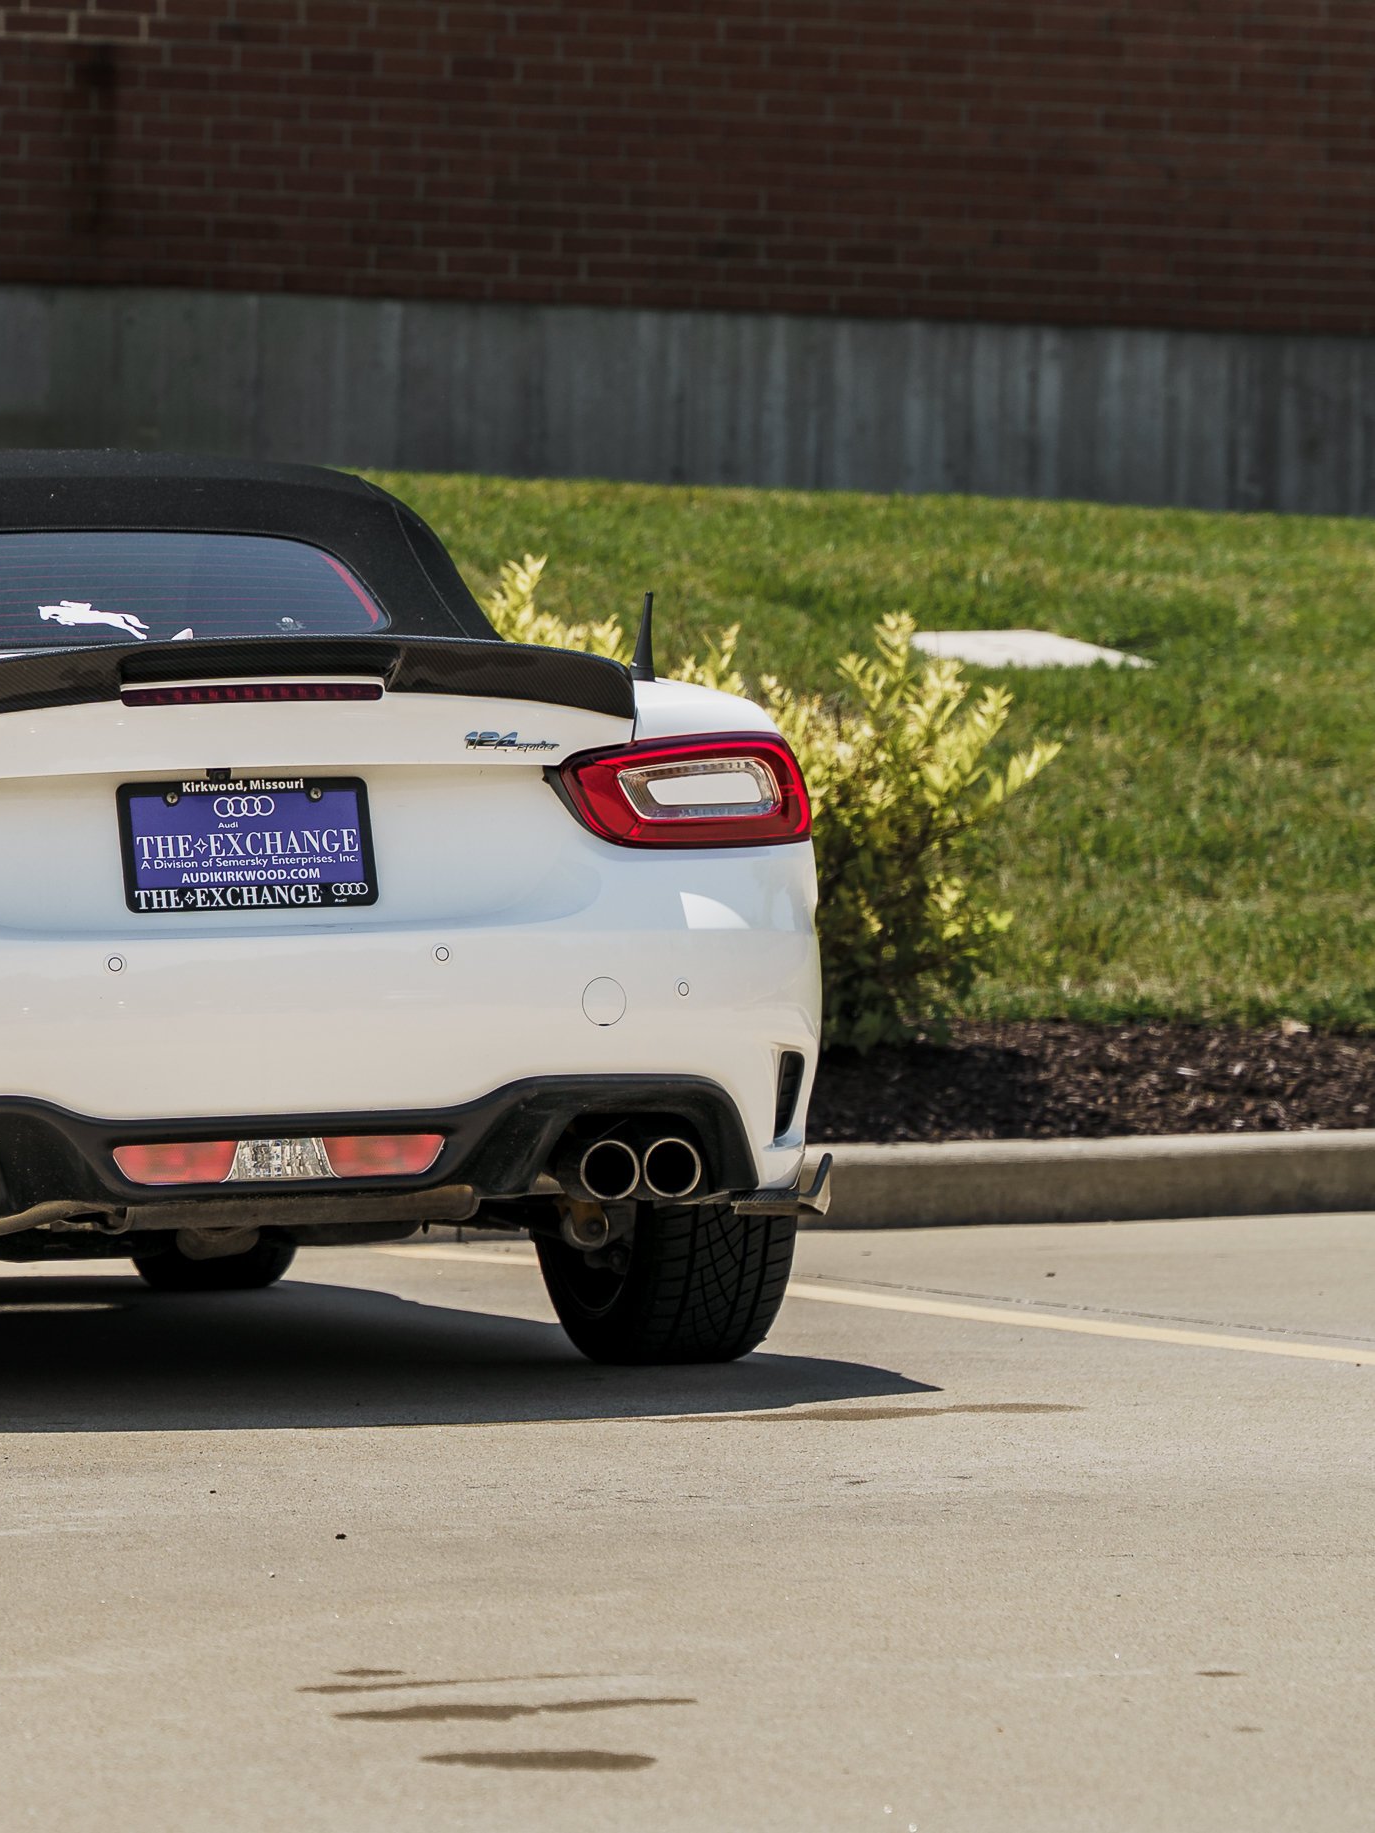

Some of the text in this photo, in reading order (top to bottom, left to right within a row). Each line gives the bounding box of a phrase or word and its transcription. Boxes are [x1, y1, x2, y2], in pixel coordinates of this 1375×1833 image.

[182, 778, 304, 793] Kirkwood, Missouri
[217, 821, 239, 829] Audi
[136, 828, 359, 860] THE EXCHANGE
[141, 853, 359, 870] A Division of Semersky Enterprises, Inc.
[181, 867, 321, 884] AUDIKIRKWOOD.COM
[134, 884, 322, 910] THE EXCHANGE
